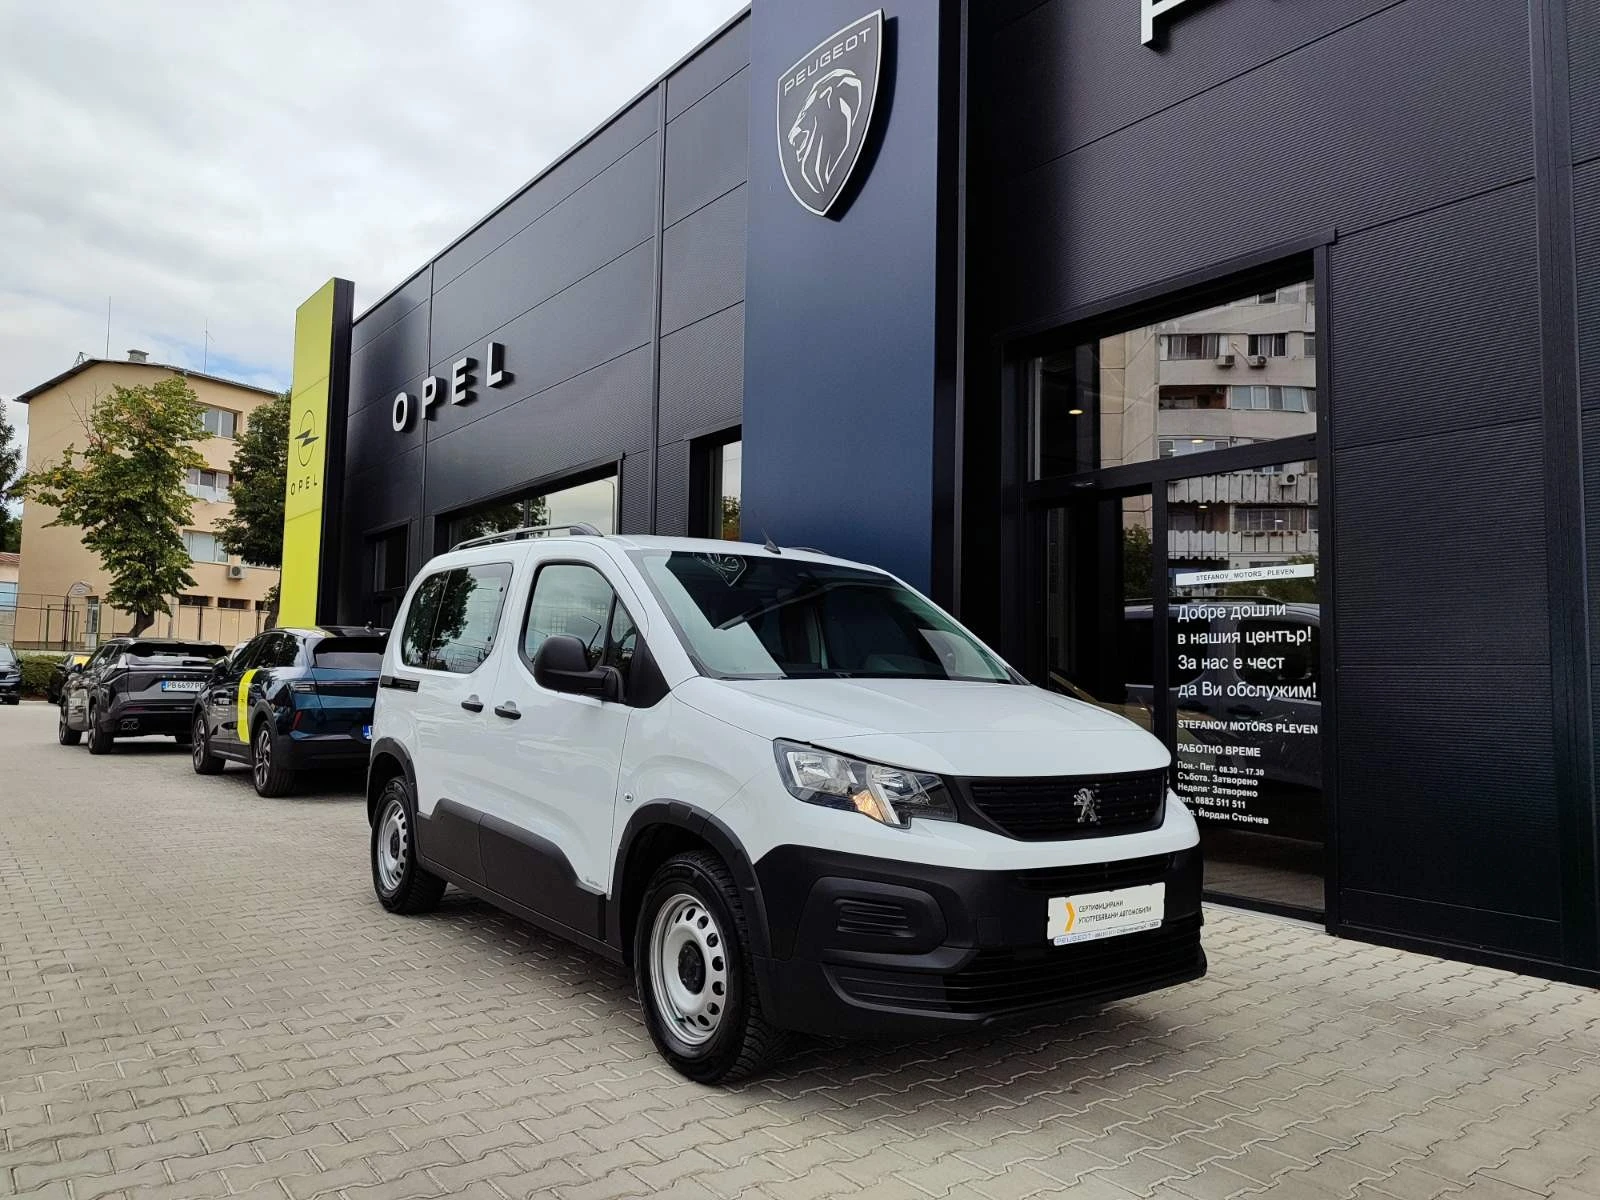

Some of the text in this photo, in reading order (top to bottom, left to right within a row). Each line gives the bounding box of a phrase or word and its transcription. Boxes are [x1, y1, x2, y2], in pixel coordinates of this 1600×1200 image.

[784, 27, 871, 96] PEUGEOT
[392, 342, 503, 432] OPEL
[290, 475, 318, 496] OPEL
[1177, 604, 1286, 622] Добре дошли
[1177, 626, 1312, 646] в нашия център!
[1178, 655, 1285, 670] За нас е чест
[1178, 681, 1317, 701] да Ви обслужим!
[1177, 719, 1318, 734] STEFANOV MOTORS PLEVEN
[1177, 743, 1261, 757] РАБОТНО ВРЕМЕ
[1212, 774, 1258, 786] Затворено
[1245, 768, 1265, 776] 17.30
[1212, 785, 1258, 797] Затворено
[1195, 796, 1214, 806] 0882
[1216, 799, 1230, 807] 511
[1232, 800, 1246, 809] 511
[1198, 807, 1230, 820] Йордан
[1232, 812, 1269, 825] Стойчев
